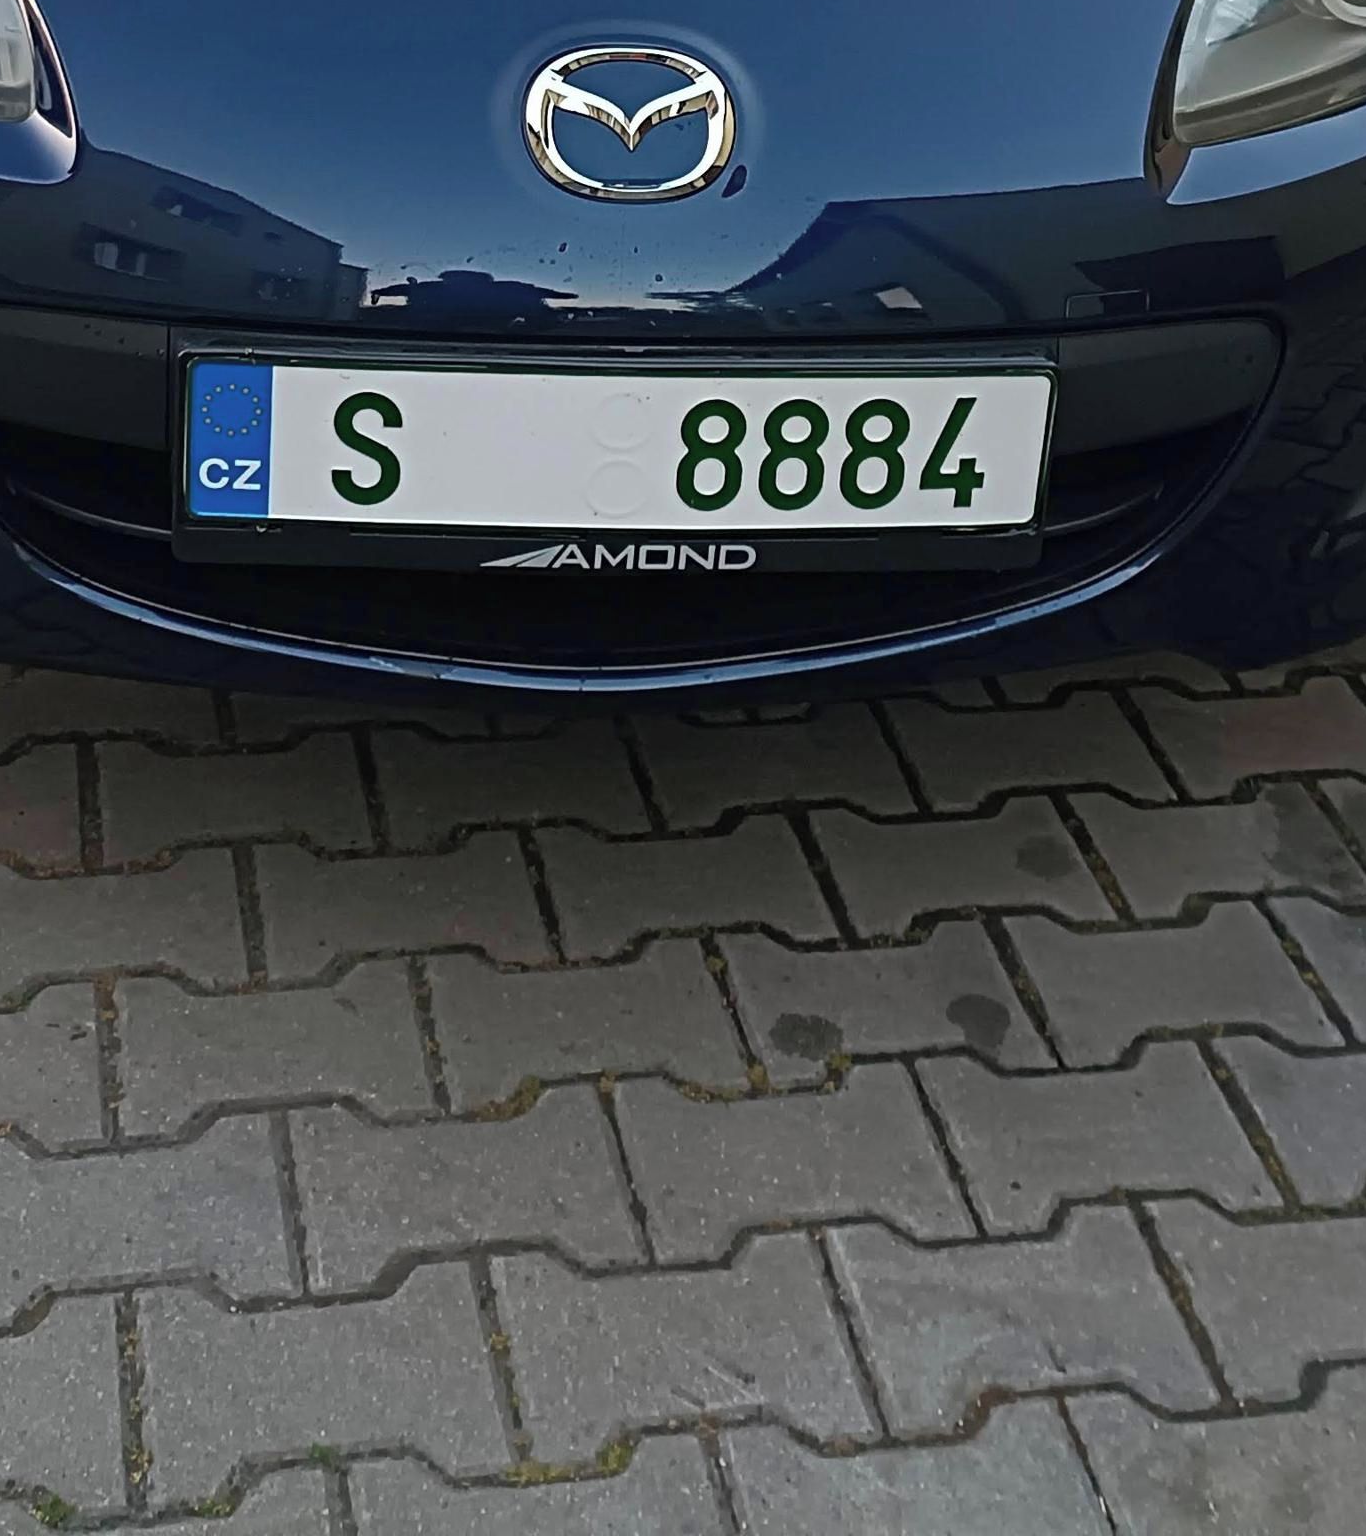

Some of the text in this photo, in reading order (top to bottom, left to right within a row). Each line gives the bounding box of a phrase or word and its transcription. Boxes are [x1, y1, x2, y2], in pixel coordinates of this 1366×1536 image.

[331, 391, 985, 512] S 8884
[199, 458, 262, 491] CZ
[551, 543, 757, 571] AMOND
